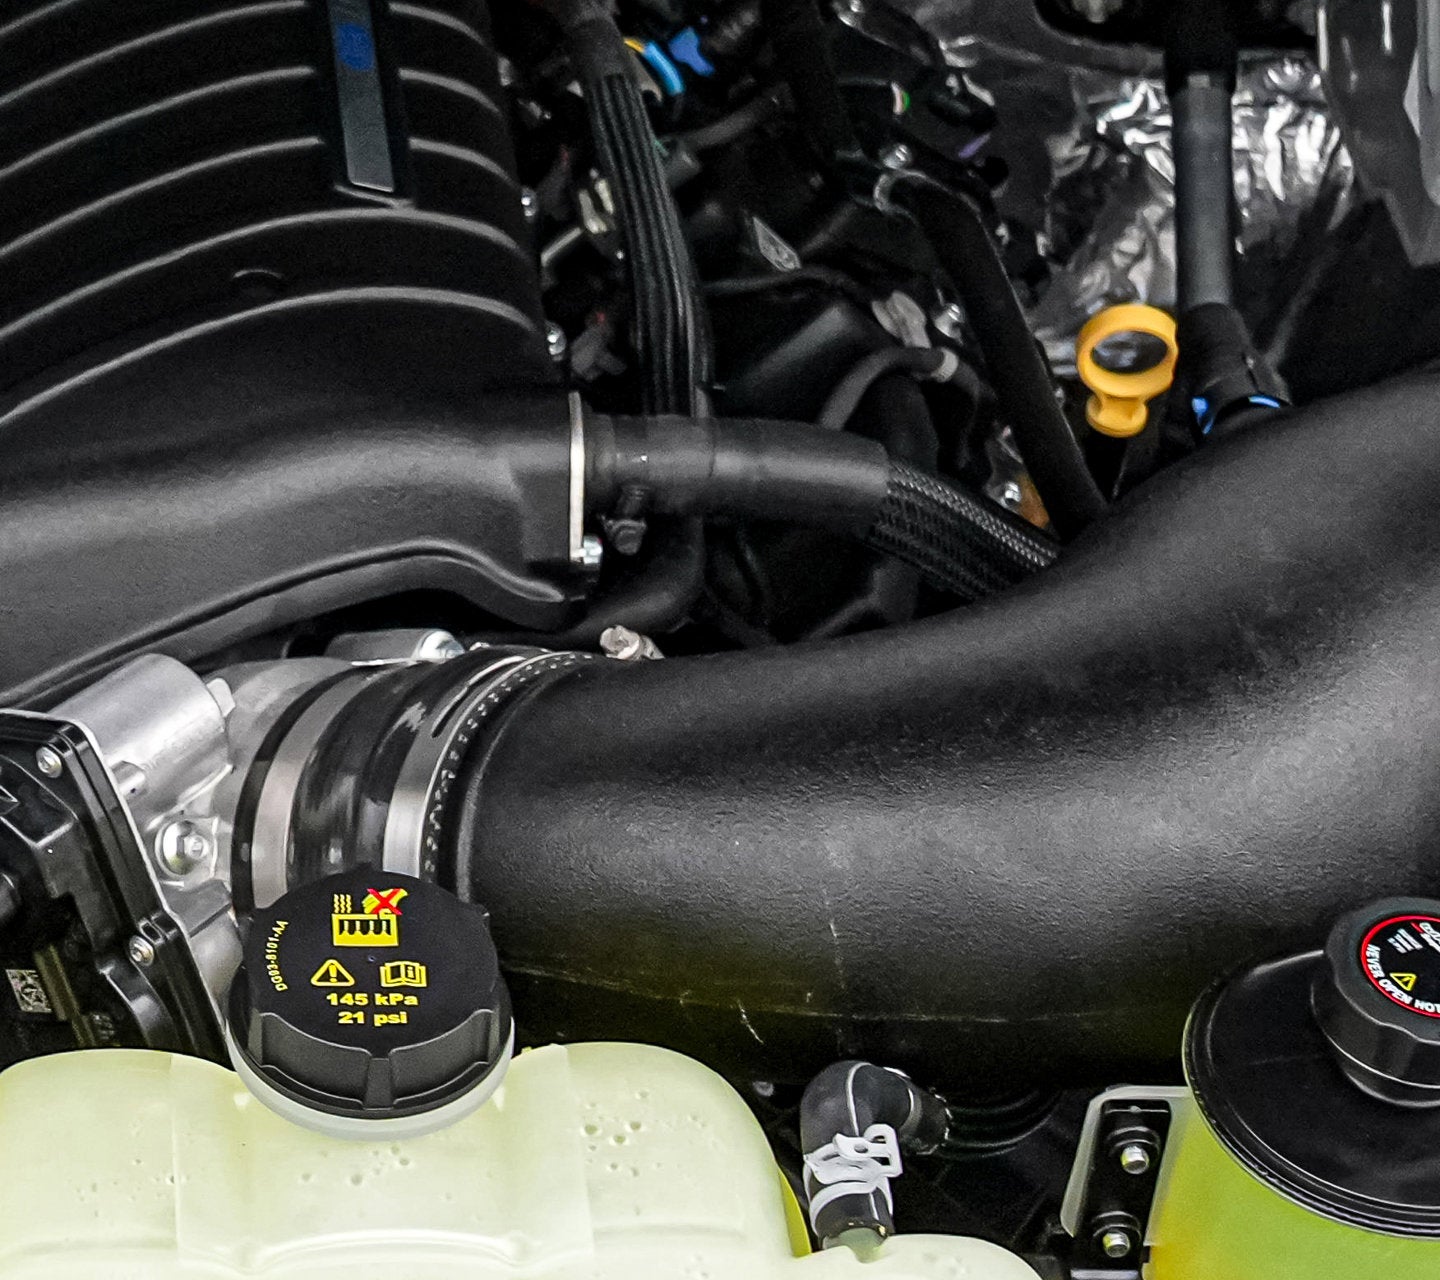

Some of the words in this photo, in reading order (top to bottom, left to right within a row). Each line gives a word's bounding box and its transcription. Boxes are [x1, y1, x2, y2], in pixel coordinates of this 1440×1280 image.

[1366, 944, 1385, 978] NEVER
[1378, 979, 1413, 1004] OPEN
[326, 993, 368, 1006] 145
[374, 993, 418, 1006] kPa
[338, 1011, 365, 1024] 21
[374, 1011, 407, 1027] psi
